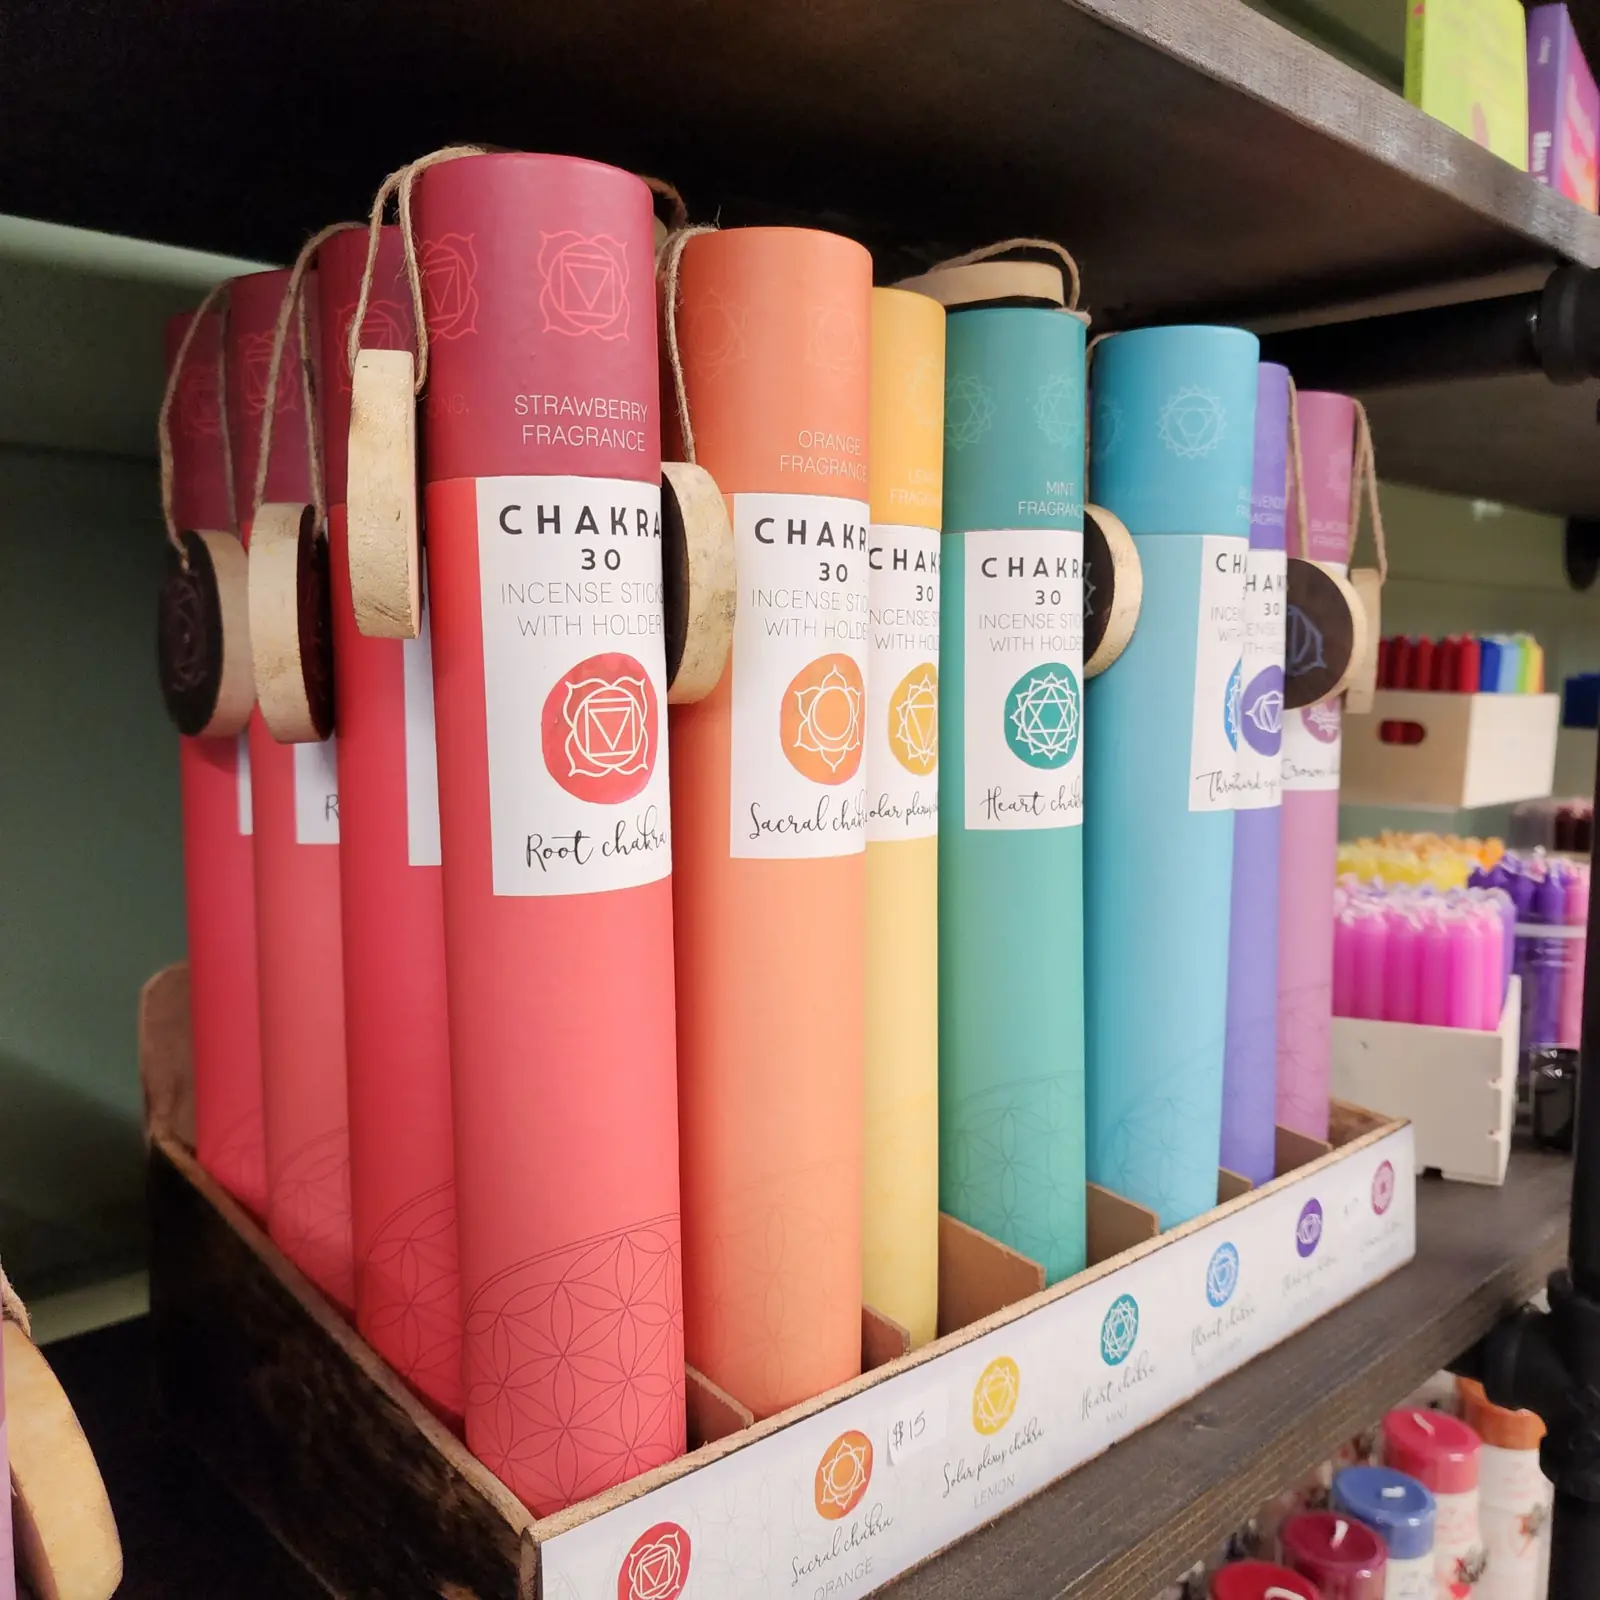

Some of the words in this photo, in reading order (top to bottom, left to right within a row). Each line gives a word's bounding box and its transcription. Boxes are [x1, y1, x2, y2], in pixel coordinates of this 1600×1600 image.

[514, 394, 648, 423] STRAWBERRY
[522, 424, 646, 452] FRAGRANCE
[798, 430, 862, 456] ORANGE
[780, 454, 867, 483] FRAGRANCE
[1046, 481, 1075, 496] MINT
[499, 504, 661, 539] CHAKRA
[581, 548, 621, 571] 30
[818, 562, 848, 582] 30
[869, 547, 940, 574] CHAK
[501, 581, 612, 605] INCENSE
[751, 588, 841, 611] INCENSE
[915, 585, 933, 602] 30
[1035, 589, 1061, 606] 30
[979, 613, 1055, 630] INCENSE
[1263, 602, 1280, 616] 30
[517, 614, 582, 637] WITH
[592, 613, 662, 636] HOLDER
[764, 617, 817, 638] WITH
[874, 633, 915, 650] WITH
[989, 636, 1034, 652] WITH
[865, 793, 902, 822] olar
[979, 785, 1045, 822] Heart
[748, 794, 830, 840] Sacral
[525, 829, 594, 872] Root
[601, 804, 667, 857] chakra
[892, 1409, 927, 1450] $15
[942, 1461, 976, 1499] Solar
[975, 1443, 1008, 1481] plexus
[1008, 1416, 1045, 1456] chakra
[973, 1474, 1016, 1509] LEMON
[790, 1526, 844, 1588] Sacral
[842, 1502, 894, 1553] chakra
[812, 1556, 874, 1600] ORANGE
